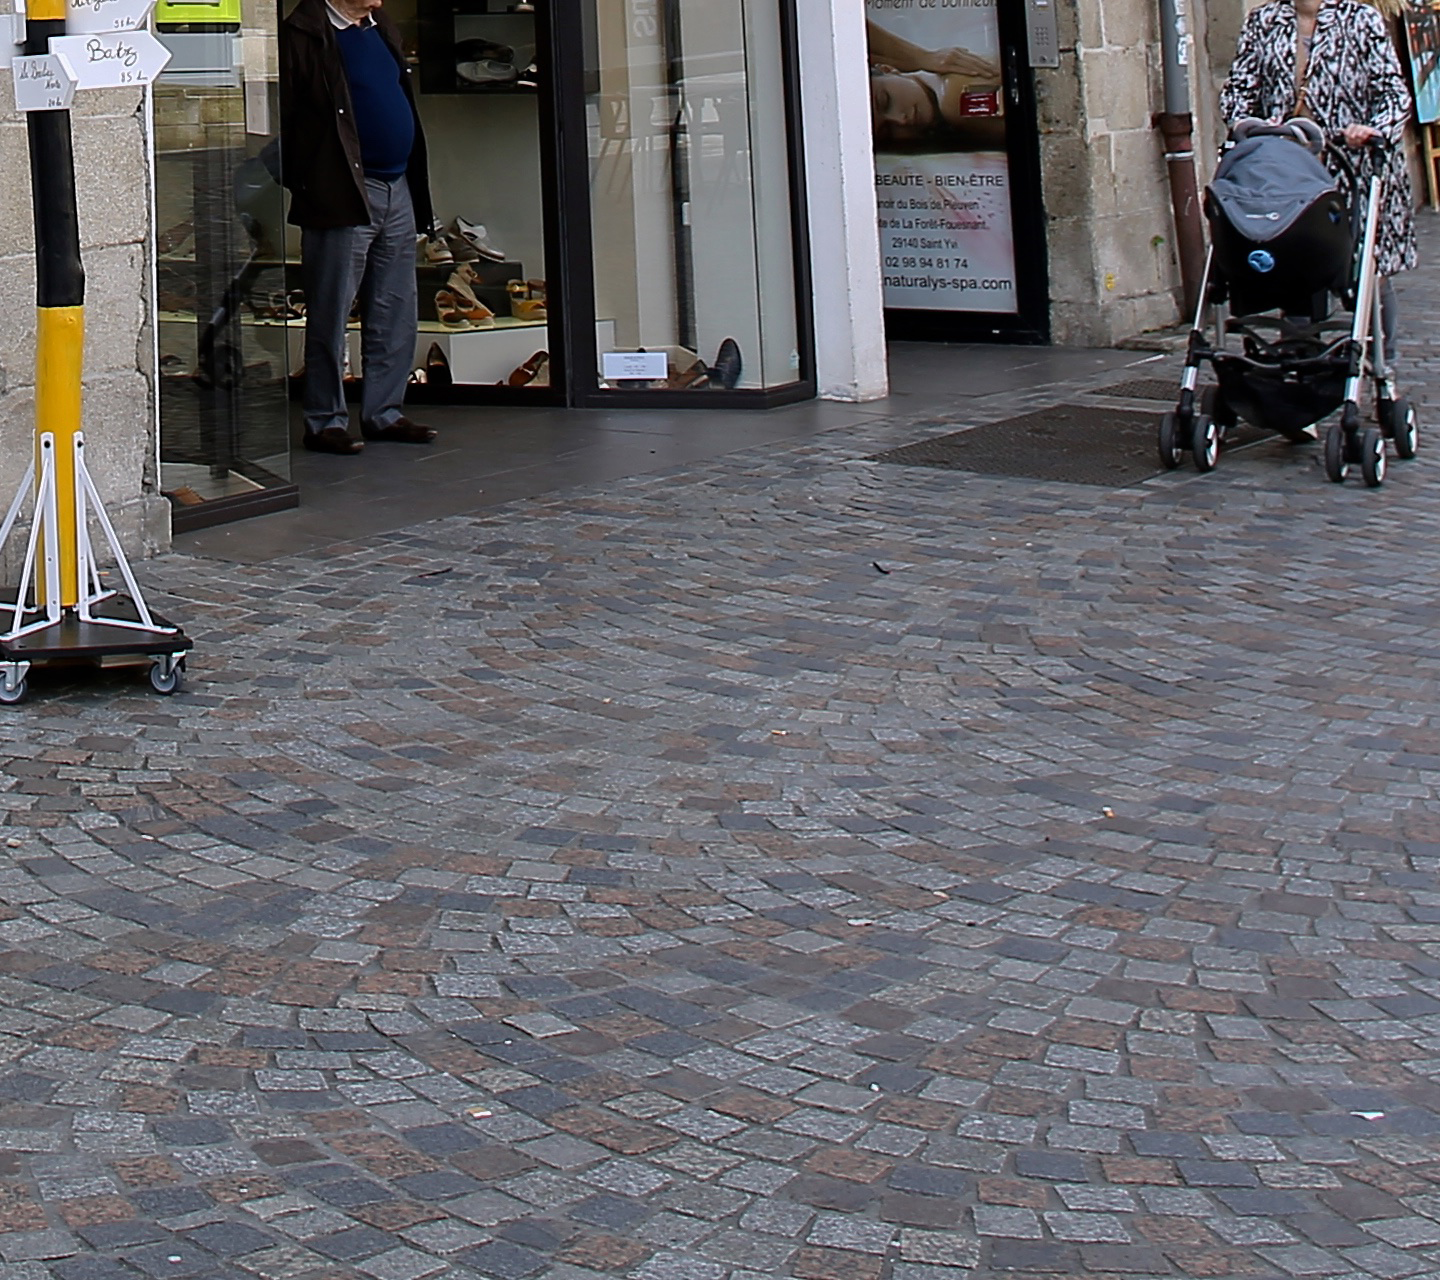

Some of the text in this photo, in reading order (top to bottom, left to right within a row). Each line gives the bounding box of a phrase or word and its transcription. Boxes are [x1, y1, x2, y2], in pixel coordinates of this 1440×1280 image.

[86, 39, 138, 67] Batz
[876, 175, 923, 186] BEAUTE
[935, 173, 1004, 186] BIEN-ÊTRE
[902, 219, 913, 229] La
[920, 238, 942, 249] Saint
[885, 257, 968, 269] 02 98 94 81 74
[883, 276, 1012, 291] naturalys-spa.com
